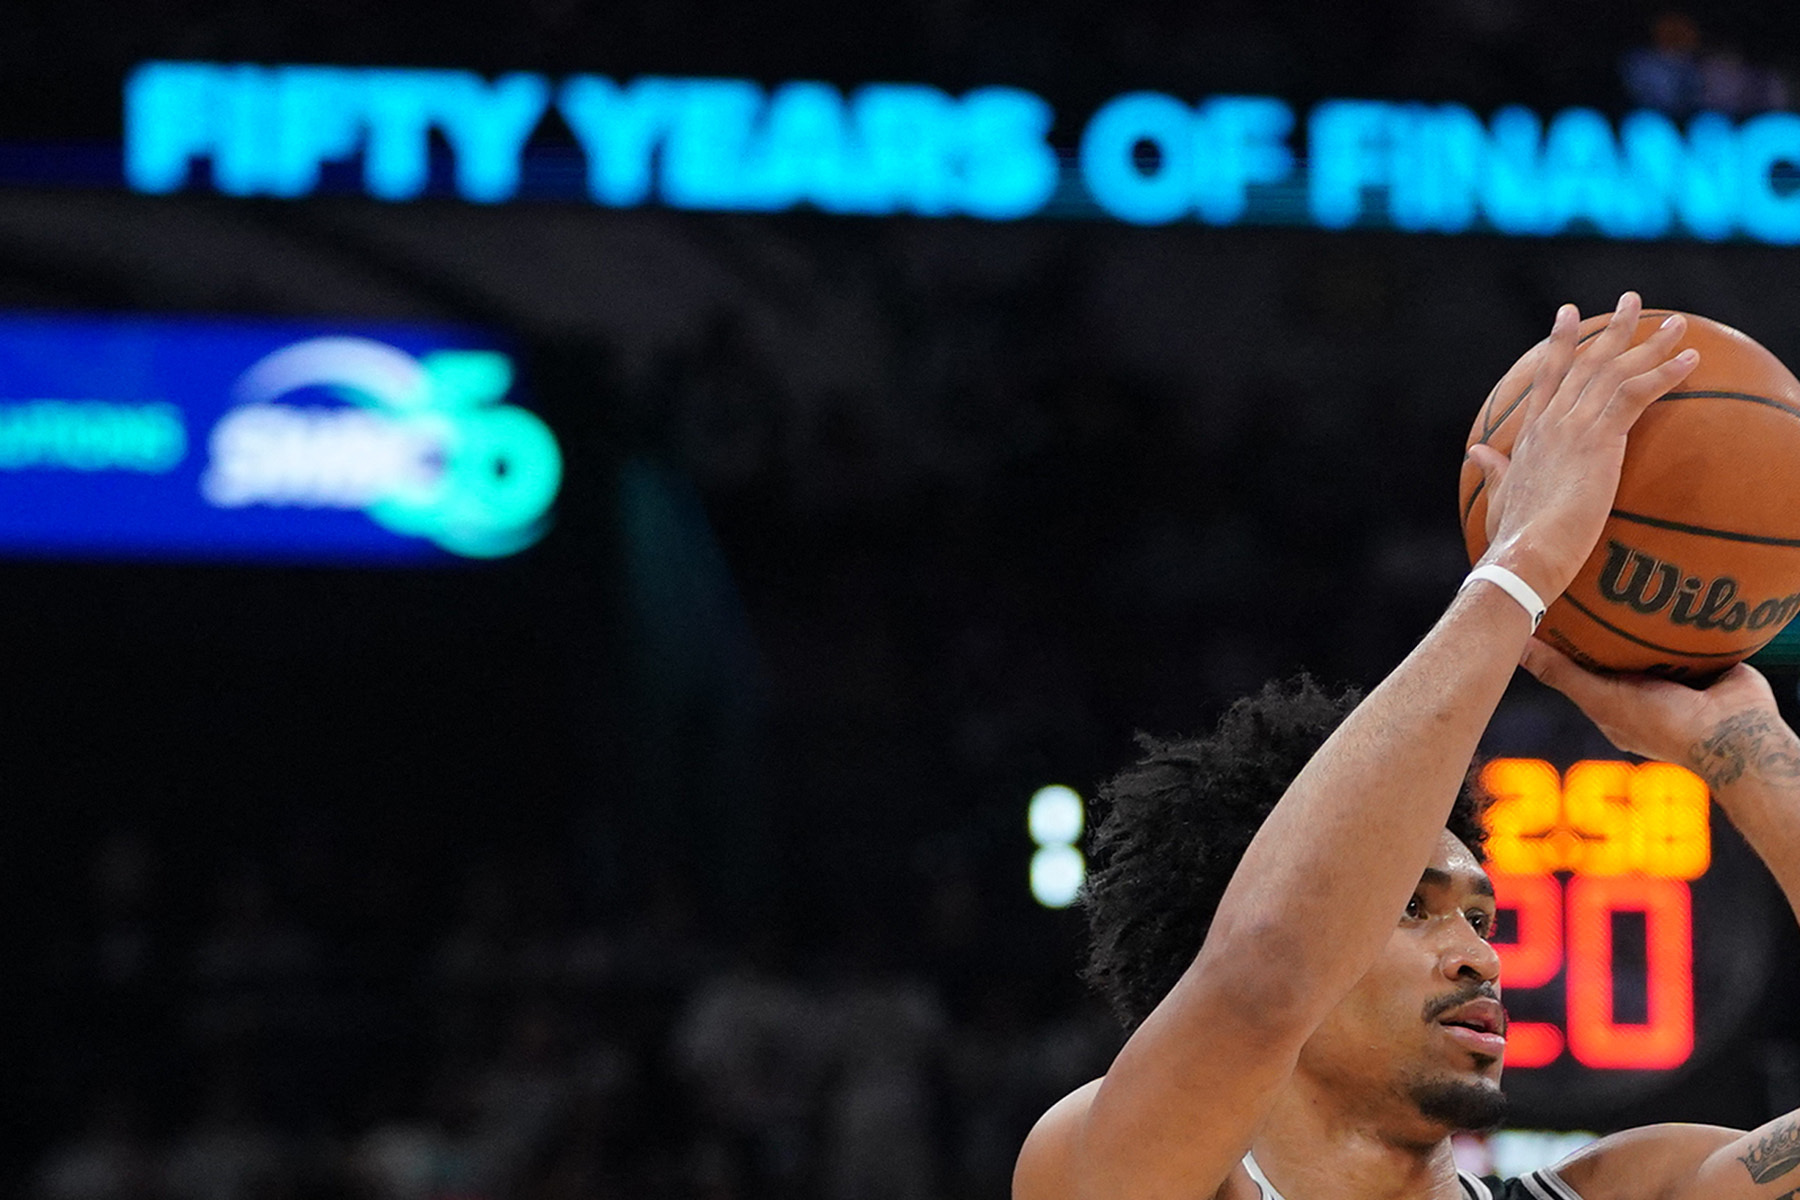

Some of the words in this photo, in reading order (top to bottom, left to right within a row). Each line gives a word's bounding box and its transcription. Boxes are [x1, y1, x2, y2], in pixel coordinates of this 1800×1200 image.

[124, 61, 550, 202] FIFTY
[558, 73, 1059, 220] YEARS
[1080, 91, 1294, 225] OF
[1488, 873, 1696, 1070] 20
